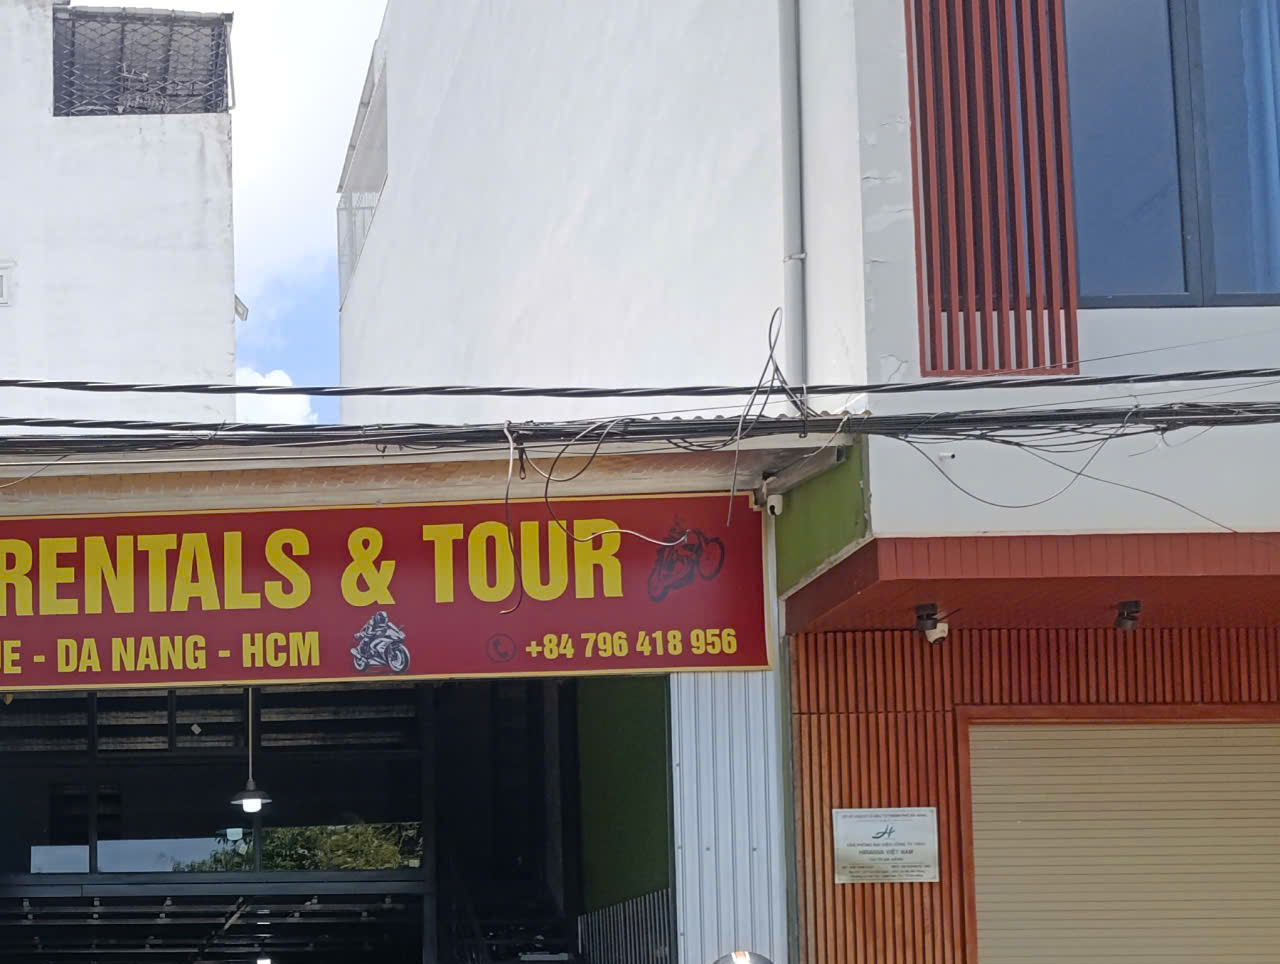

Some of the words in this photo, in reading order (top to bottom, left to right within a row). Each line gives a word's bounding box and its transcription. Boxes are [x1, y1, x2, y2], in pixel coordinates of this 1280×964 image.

[340, 526, 396, 607] &
[422, 518, 624, 604] TOUR
[57, 638, 101, 673] DA
[111, 634, 207, 672] NANG
[242, 631, 320, 668] HCM
[526, 633, 575, 660] +84
[581, 630, 628, 658] 796
[635, 629, 683, 656] 418
[690, 628, 737, 655] 956
